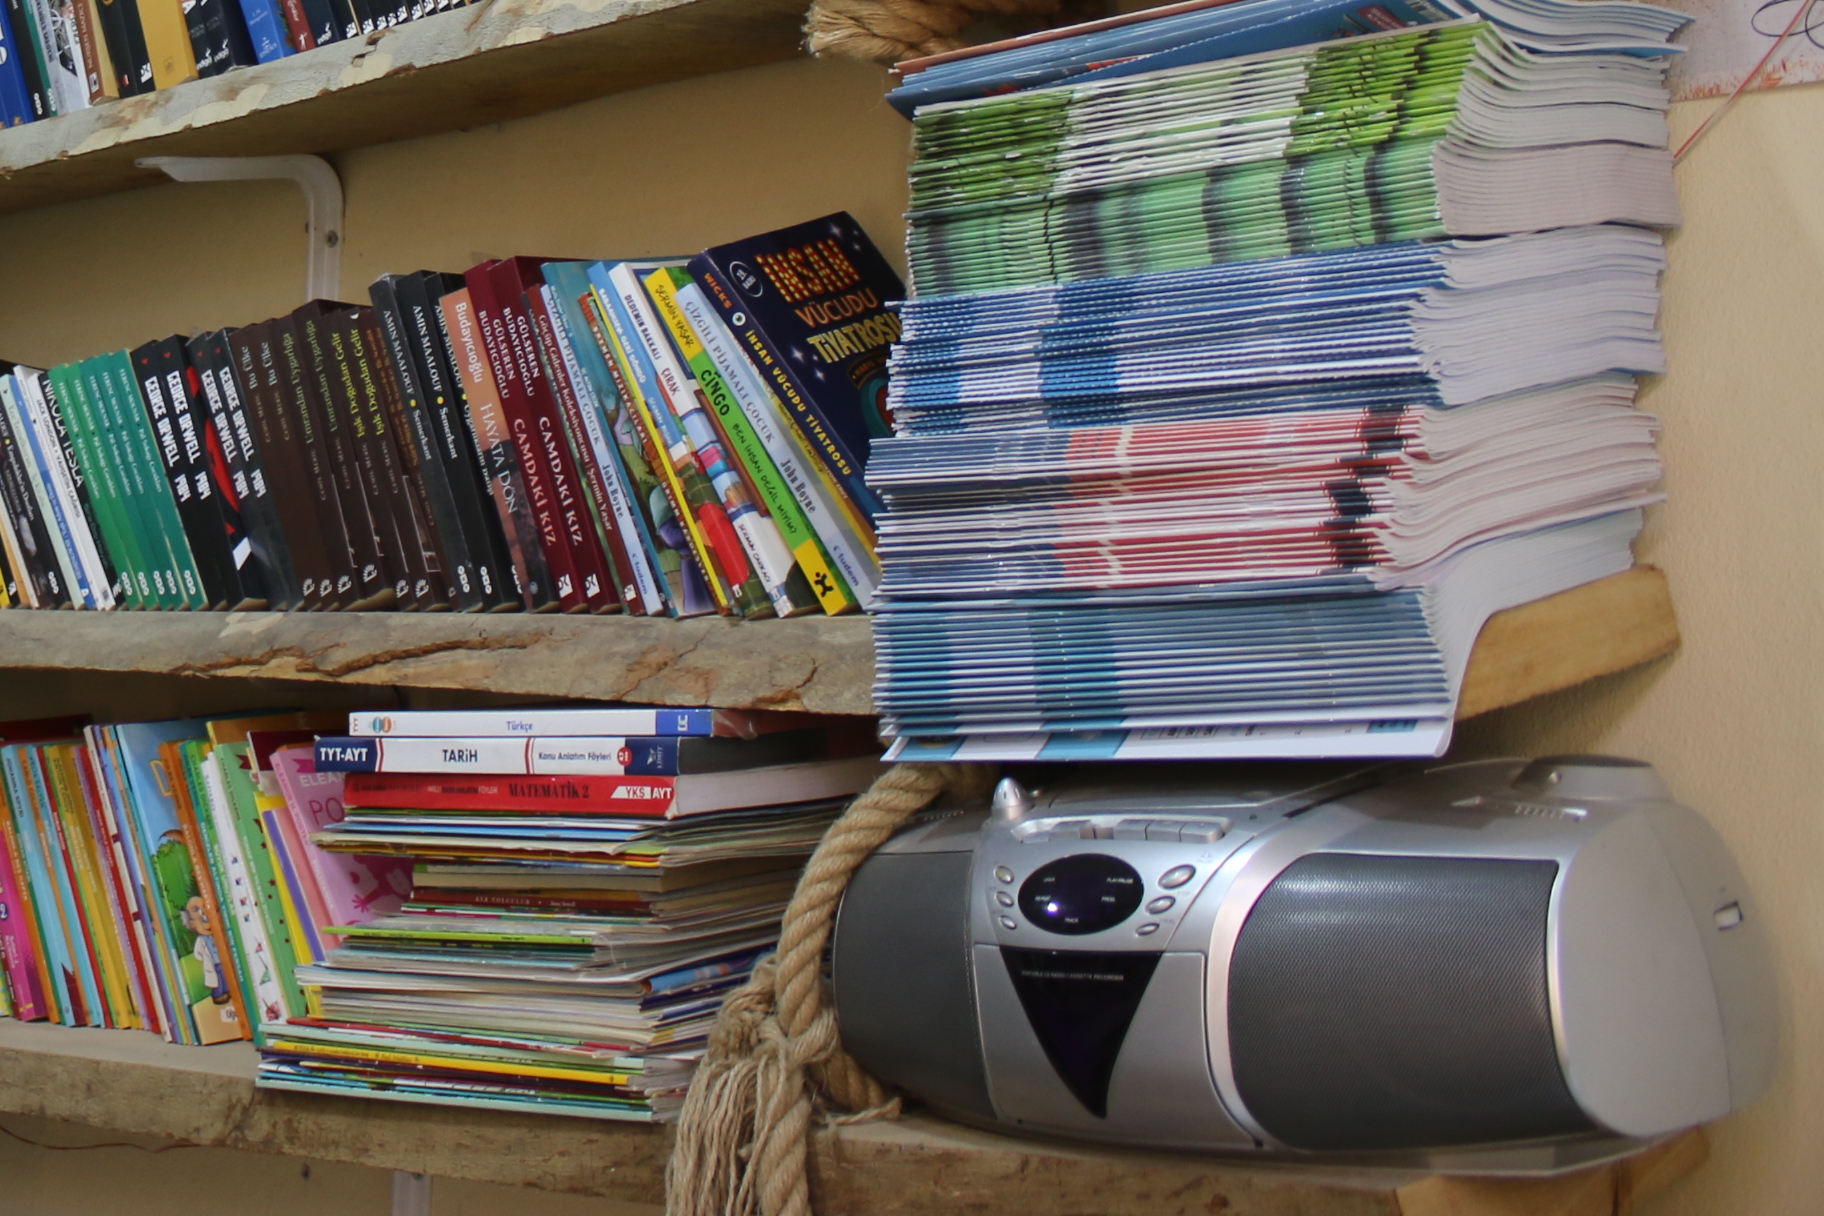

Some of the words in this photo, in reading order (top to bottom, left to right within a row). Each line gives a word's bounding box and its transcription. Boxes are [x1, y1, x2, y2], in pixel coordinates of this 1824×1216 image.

[754, 237, 863, 304] İNSAN
[413, 305, 428, 334] AMIN
[794, 288, 881, 329] VÜCUDU
[806, 312, 904, 364] TİYATROSU
[419, 334, 444, 392] MAALOUF
[455, 302, 484, 383] Budayıcıoğlu
[502, 306, 536, 397] BUDAYICIOĞLU
[517, 315, 541, 378] GÜLSEREN
[624, 294, 648, 332] DEDEMİN
[643, 330, 663, 361] BAKKALI
[660, 367, 683, 397] ÇIRAK
[703, 272, 734, 309] WICKS
[744, 330, 775, 366] İNSAN
[771, 367, 808, 412] VÜCUDU
[804, 412, 853, 476] TİYATROSU
[145, 375, 167, 419] GEORGE
[157, 417, 181, 468] ORWELL
[175, 474, 193, 503] 1984
[438, 407, 459, 459] Semerkant
[684, 300, 717, 347] ÇİZGİLİ
[710, 345, 749, 403] PİJAMALI
[744, 400, 776, 445] ÇOCUK
[778, 458, 799, 484] John
[793, 481, 818, 515] Boyne
[480, 403, 505, 468] HAYATA
[498, 469, 519, 515] DÖN
[538, 416, 572, 508] CAMDAKİ
[566, 510, 585, 546] KIZ
[319, 746, 370, 763] TYT-AYT
[441, 748, 479, 764] TARİH
[537, 751, 557, 762] Konu
[557, 751, 586, 762] Anlatım
[586, 751, 613, 762] Föyleri
[505, 720, 535, 733] Türkçe
[507, 780, 580, 800] MATEMATİK
